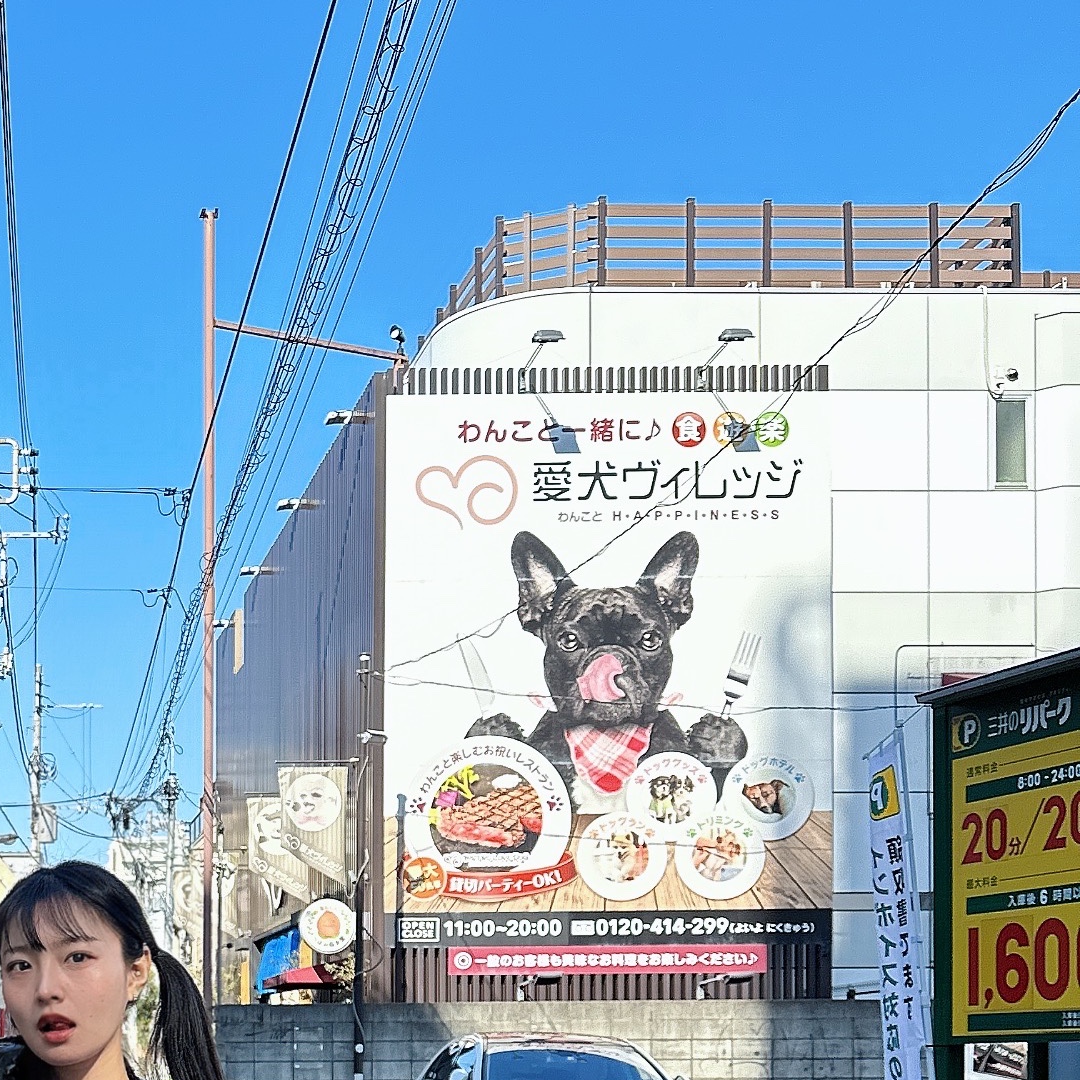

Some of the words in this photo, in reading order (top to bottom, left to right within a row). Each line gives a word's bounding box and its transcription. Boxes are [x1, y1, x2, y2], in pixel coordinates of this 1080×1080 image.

[457, 417, 642, 442] わんこと一緒に
[675, 415, 703, 442] 食
[758, 415, 786, 442] 楽
[533, 459, 804, 501] 愛犬ヴィレッジ
[557, 511, 603, 522] わんこと
[986, 696, 1072, 736] 三井のリパーク
[420, 745, 555, 794] わんこと楽しむお祝いレストラン
[1040, 889, 1048, 905] 6
[401, 921, 435, 930] OPEN
[401, 929, 435, 939] CLOSE
[595, 917, 730, 936] 0120-414-299
[967, 917, 1080, 1009] 1,60
